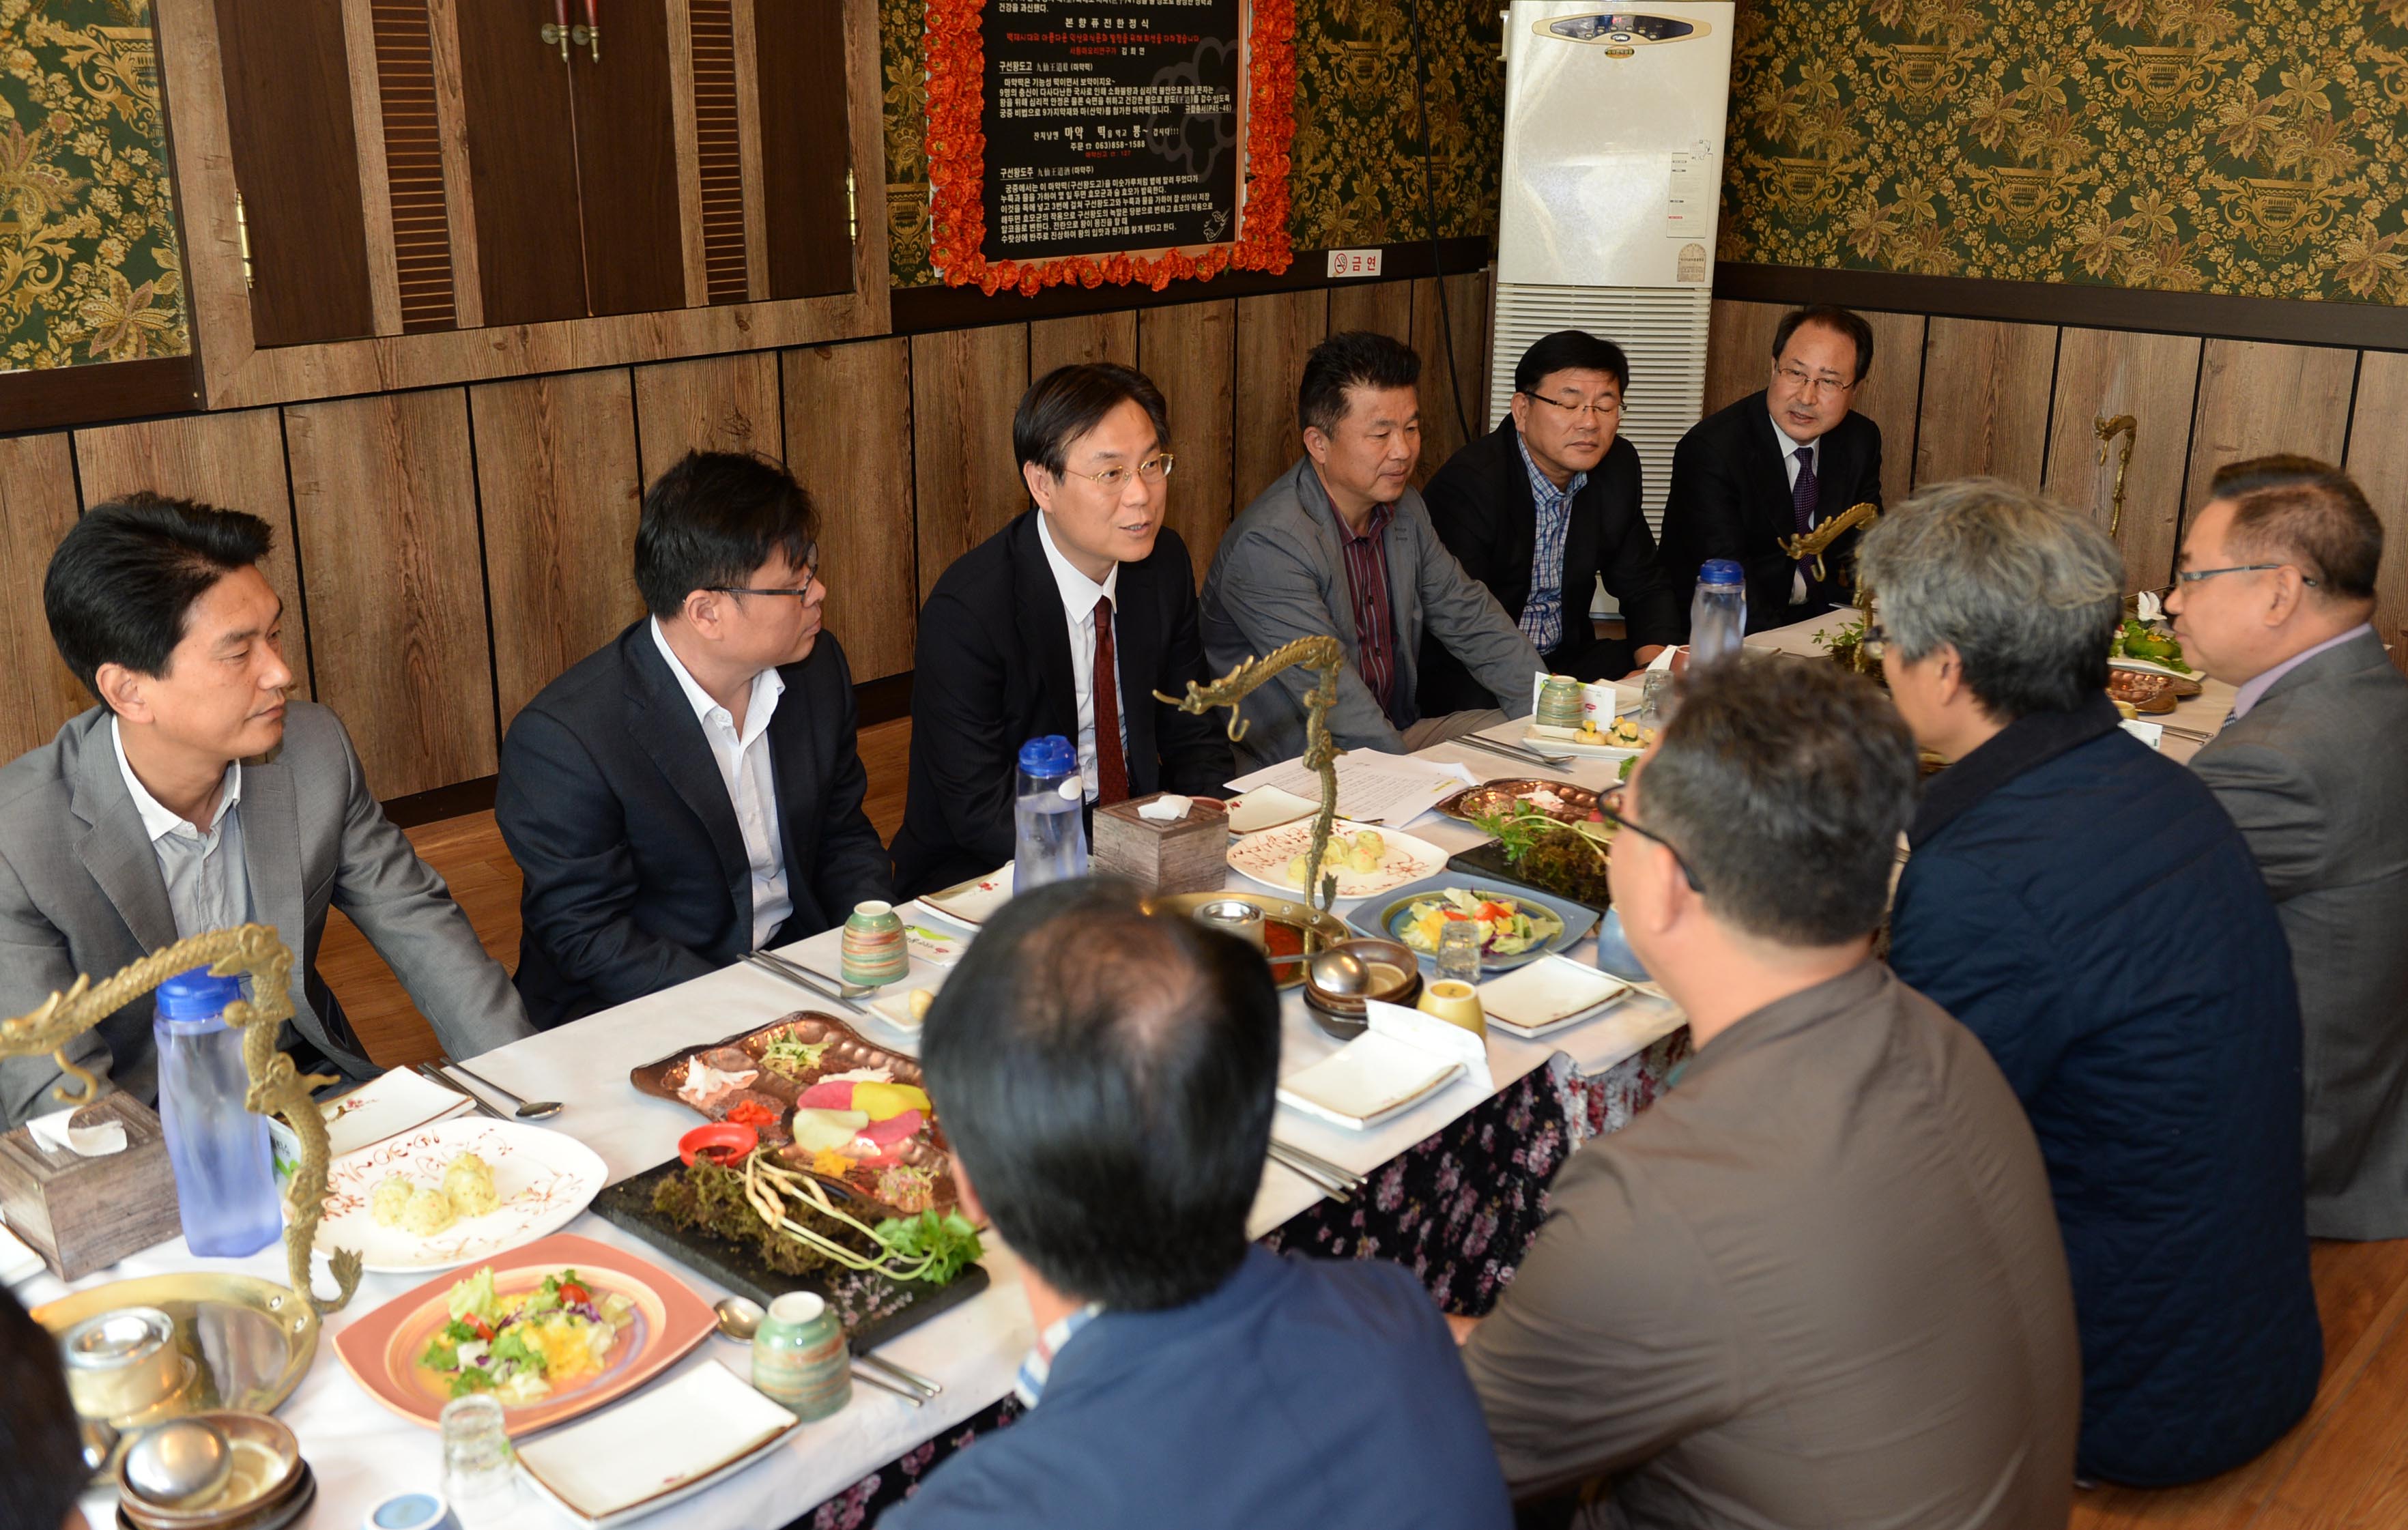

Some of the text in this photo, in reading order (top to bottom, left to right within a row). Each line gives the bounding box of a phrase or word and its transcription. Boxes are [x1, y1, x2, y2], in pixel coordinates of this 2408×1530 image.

[999, 3, 1018, 12] 건강을
[999, 61, 1032, 72] 구선왕도고
[1005, 78, 1031, 87] 마약떡은
[1033, 78, 1051, 87] 기능성
[1053, 78, 1078, 87] 떡이면서
[1000, 88, 1017, 98] 9명의
[1040, 87, 1072, 97] 다사다난한
[1074, 87, 1092, 96] 국사로
[1094, 87, 1106, 96] 인해
[1108, 87, 1138, 97] 소화불량과
[1140, 86, 1157, 96] 심리적
[1000, 98, 1013, 107] 왕을
[1015, 97, 1027, 106] 위해
[1029, 98, 1048, 106] 심리적
[1050, 97, 1070, 106] 안정은
[1071, 97, 1083, 106] 물론
[1085, 97, 1104, 105] 숙면을
[1106, 96, 1123, 105] 취하고
[1126, 96, 1143, 104] 건강한
[1145, 95, 1162, 104] 몸으로
[1000, 109, 1013, 118] 궁중
[1015, 109, 1041, 117] 비법으로
[1132, 106, 1150, 115] 마약떡
[1065, 126, 1083, 140] 마약
[1070, 140, 1145, 151] 주문 063)858-1588
[1001, 167, 1033, 178] 구선왕도주
[1005, 184, 1038, 193] 궁중에서는
[1001, 194, 1020, 203] 누룩과
[1037, 192, 1056, 201] 가하여
[1074, 190, 1086, 199] 두면
[1088, 189, 1113, 198] 효모균과
[1121, 187, 1139, 196] 효모가
[1001, 204, 1020, 214] 이것을
[1037, 203, 1050, 212] 넣고
[1052, 201, 1068, 210] 3번에
[1085, 199, 1121, 208] 구선왕도고와
[1156, 195, 1172, 203] 가하여
[1022, 213, 1048, 222] 효모균의
[1050, 212, 1076, 220] 작용으로
[1078, 210, 1108, 219] 구선왕도의
[1054, 220, 1078, 230] 전란으로
[1080, 220, 1092, 229] 왕이
[1001, 233, 1027, 244] 수랏상에
[1029, 232, 1049, 242] 반주로
[1051, 230, 1076, 240] 진상하여
[1078, 229, 1090, 238] 왕의
[1092, 227, 1110, 237] 입맛과
